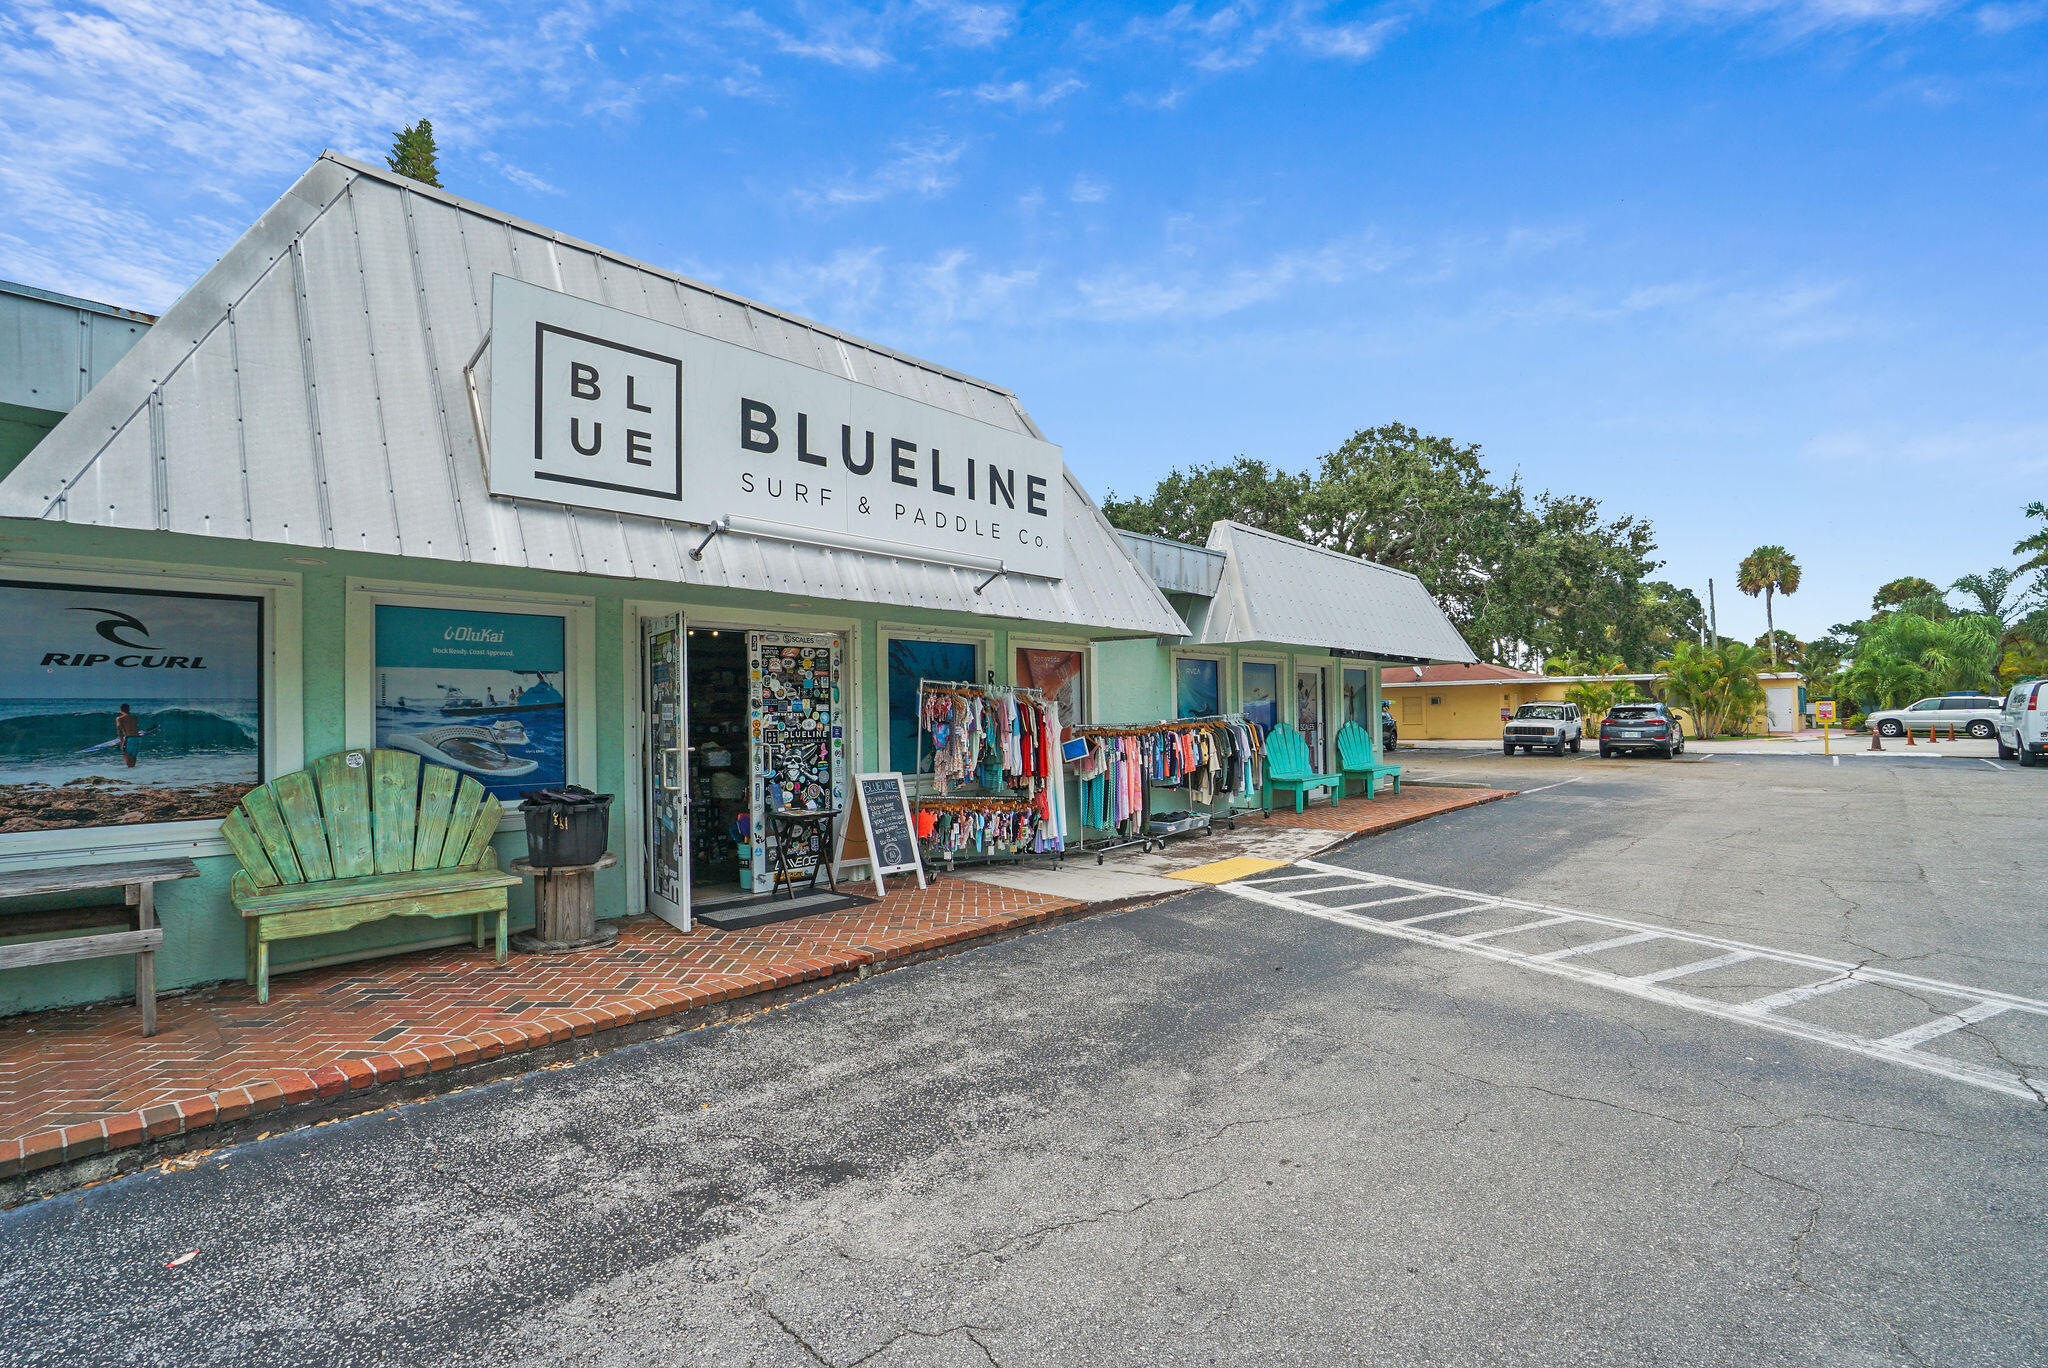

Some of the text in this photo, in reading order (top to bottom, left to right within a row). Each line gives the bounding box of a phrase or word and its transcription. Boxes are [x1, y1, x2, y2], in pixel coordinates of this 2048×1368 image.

[741, 397, 1048, 518] BLUELINE
[741, 472, 832, 506] SURF
[858, 496, 871, 515] &
[895, 503, 1001, 540] PADDLE
[454, 626, 505, 643] OluKai
[40, 653, 208, 669] RIP CURL
[487, 649, 515, 658] Approved.
[803, 649, 813, 657] LF
